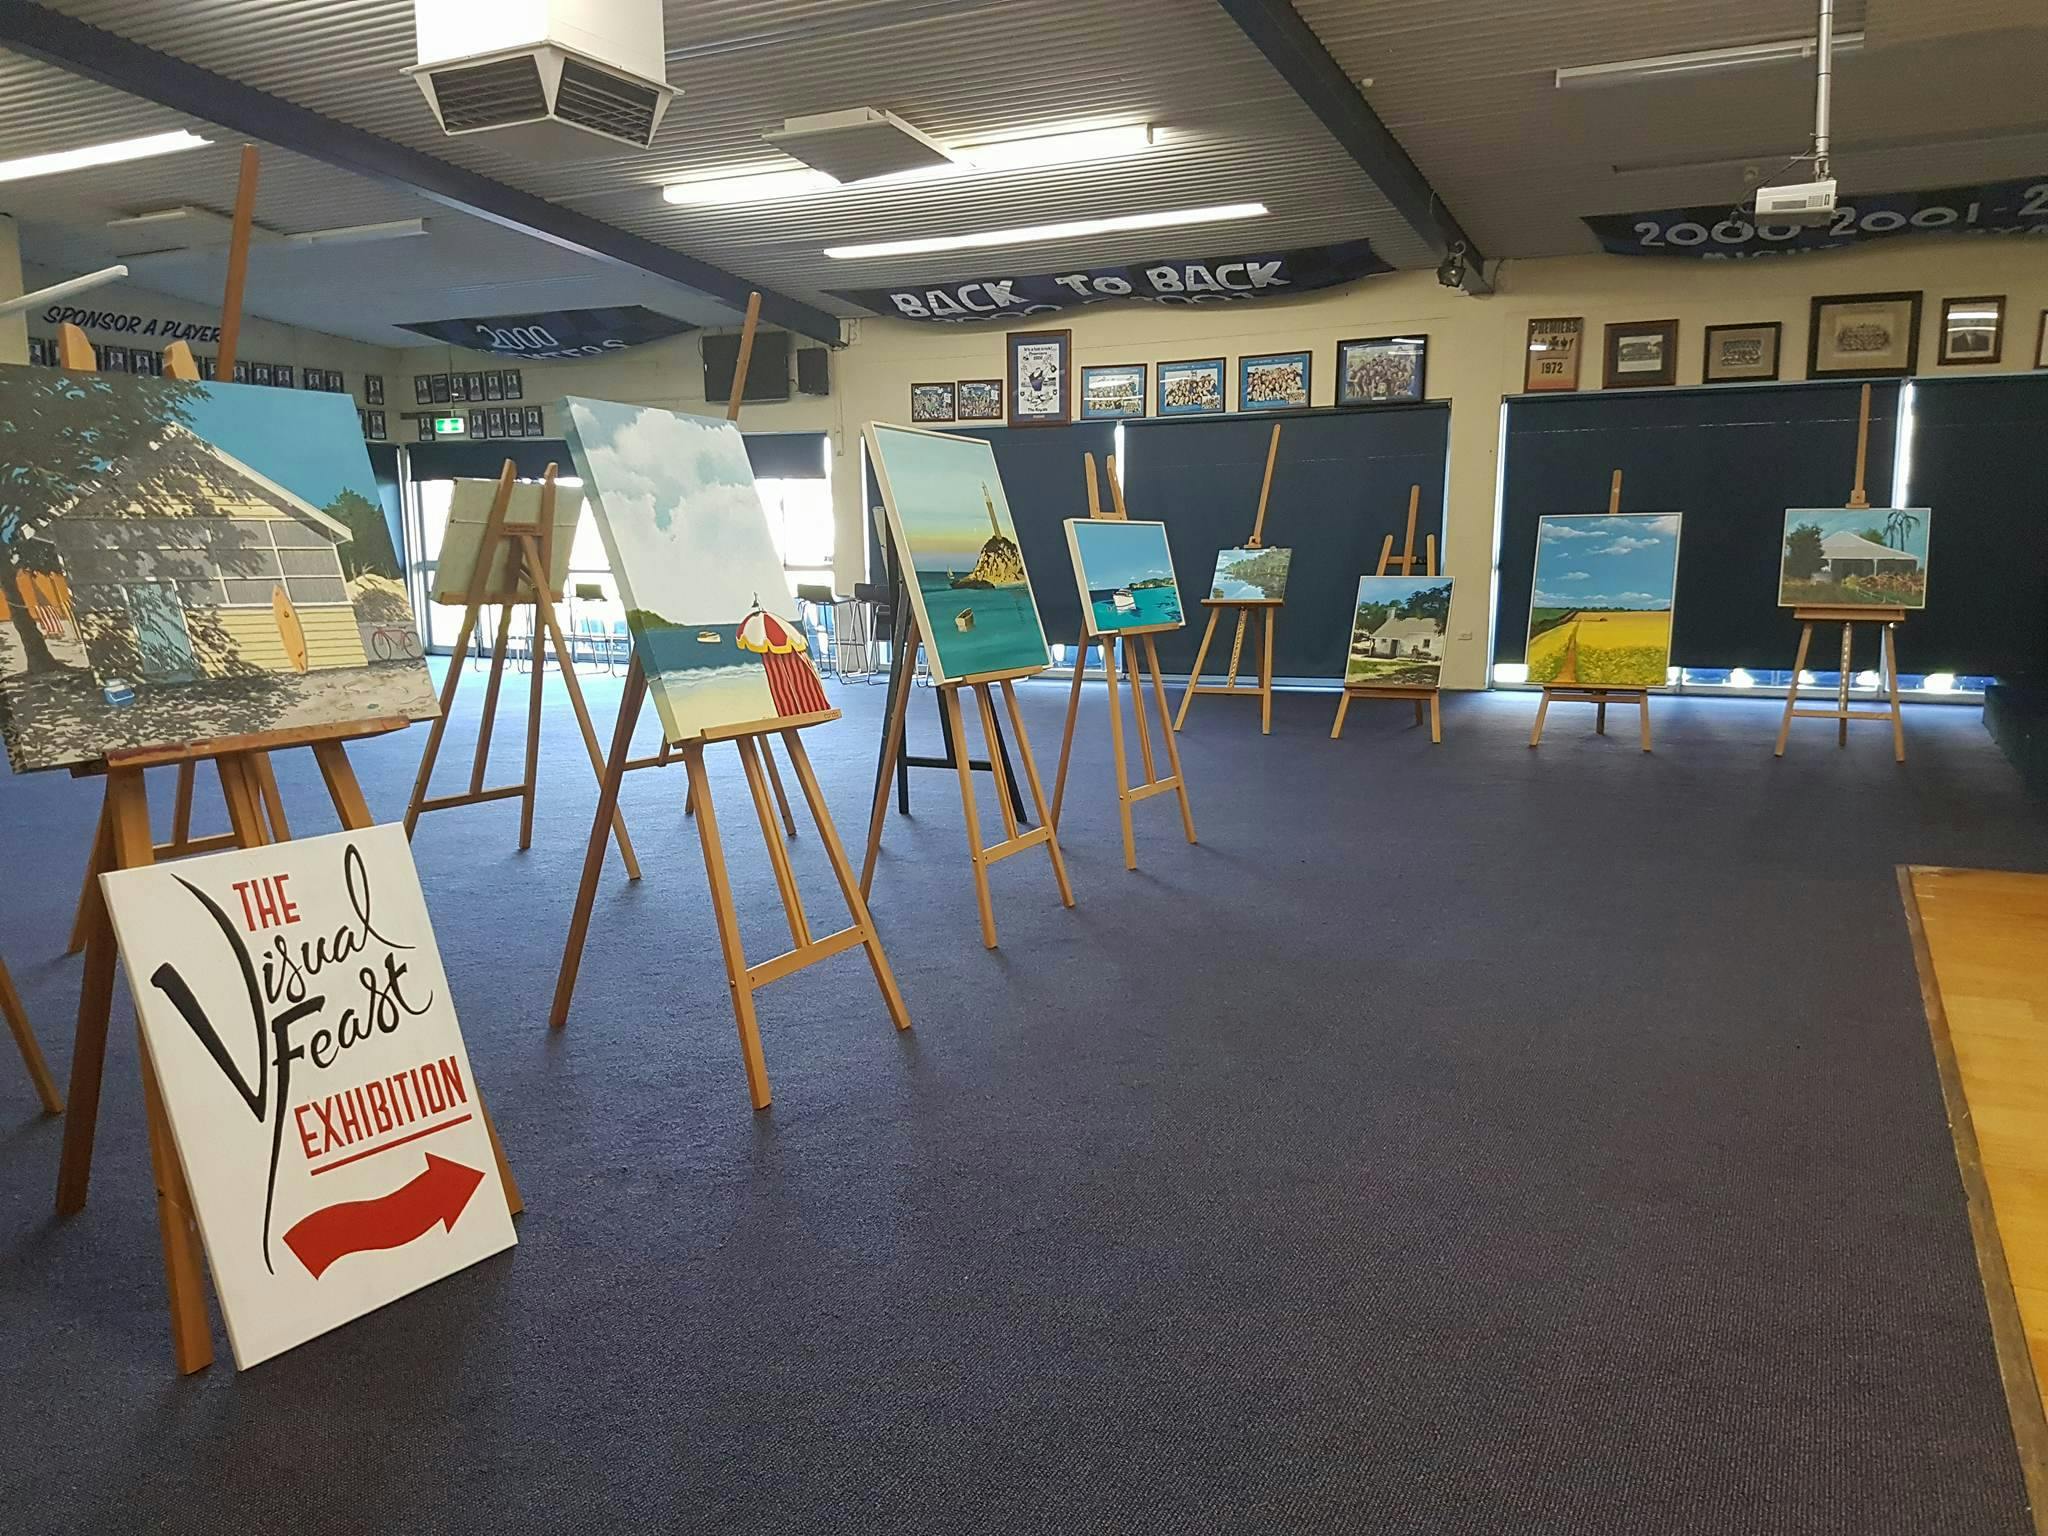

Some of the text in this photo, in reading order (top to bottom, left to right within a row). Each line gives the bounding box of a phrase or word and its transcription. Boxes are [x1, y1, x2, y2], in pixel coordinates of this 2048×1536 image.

[890, 280, 1029, 318] BACK
[1146, 260, 1291, 292] BACK
[42, 306, 221, 343] SPONSOR A PLAYER
[475, 324, 559, 350] 2000
[1541, 362, 1563, 375] 1972
[232, 874, 301, 932] THE
[150, 843, 416, 1123] Visual
[262, 952, 433, 1275] Feast
[294, 1055, 468, 1160] EXHIBITION
